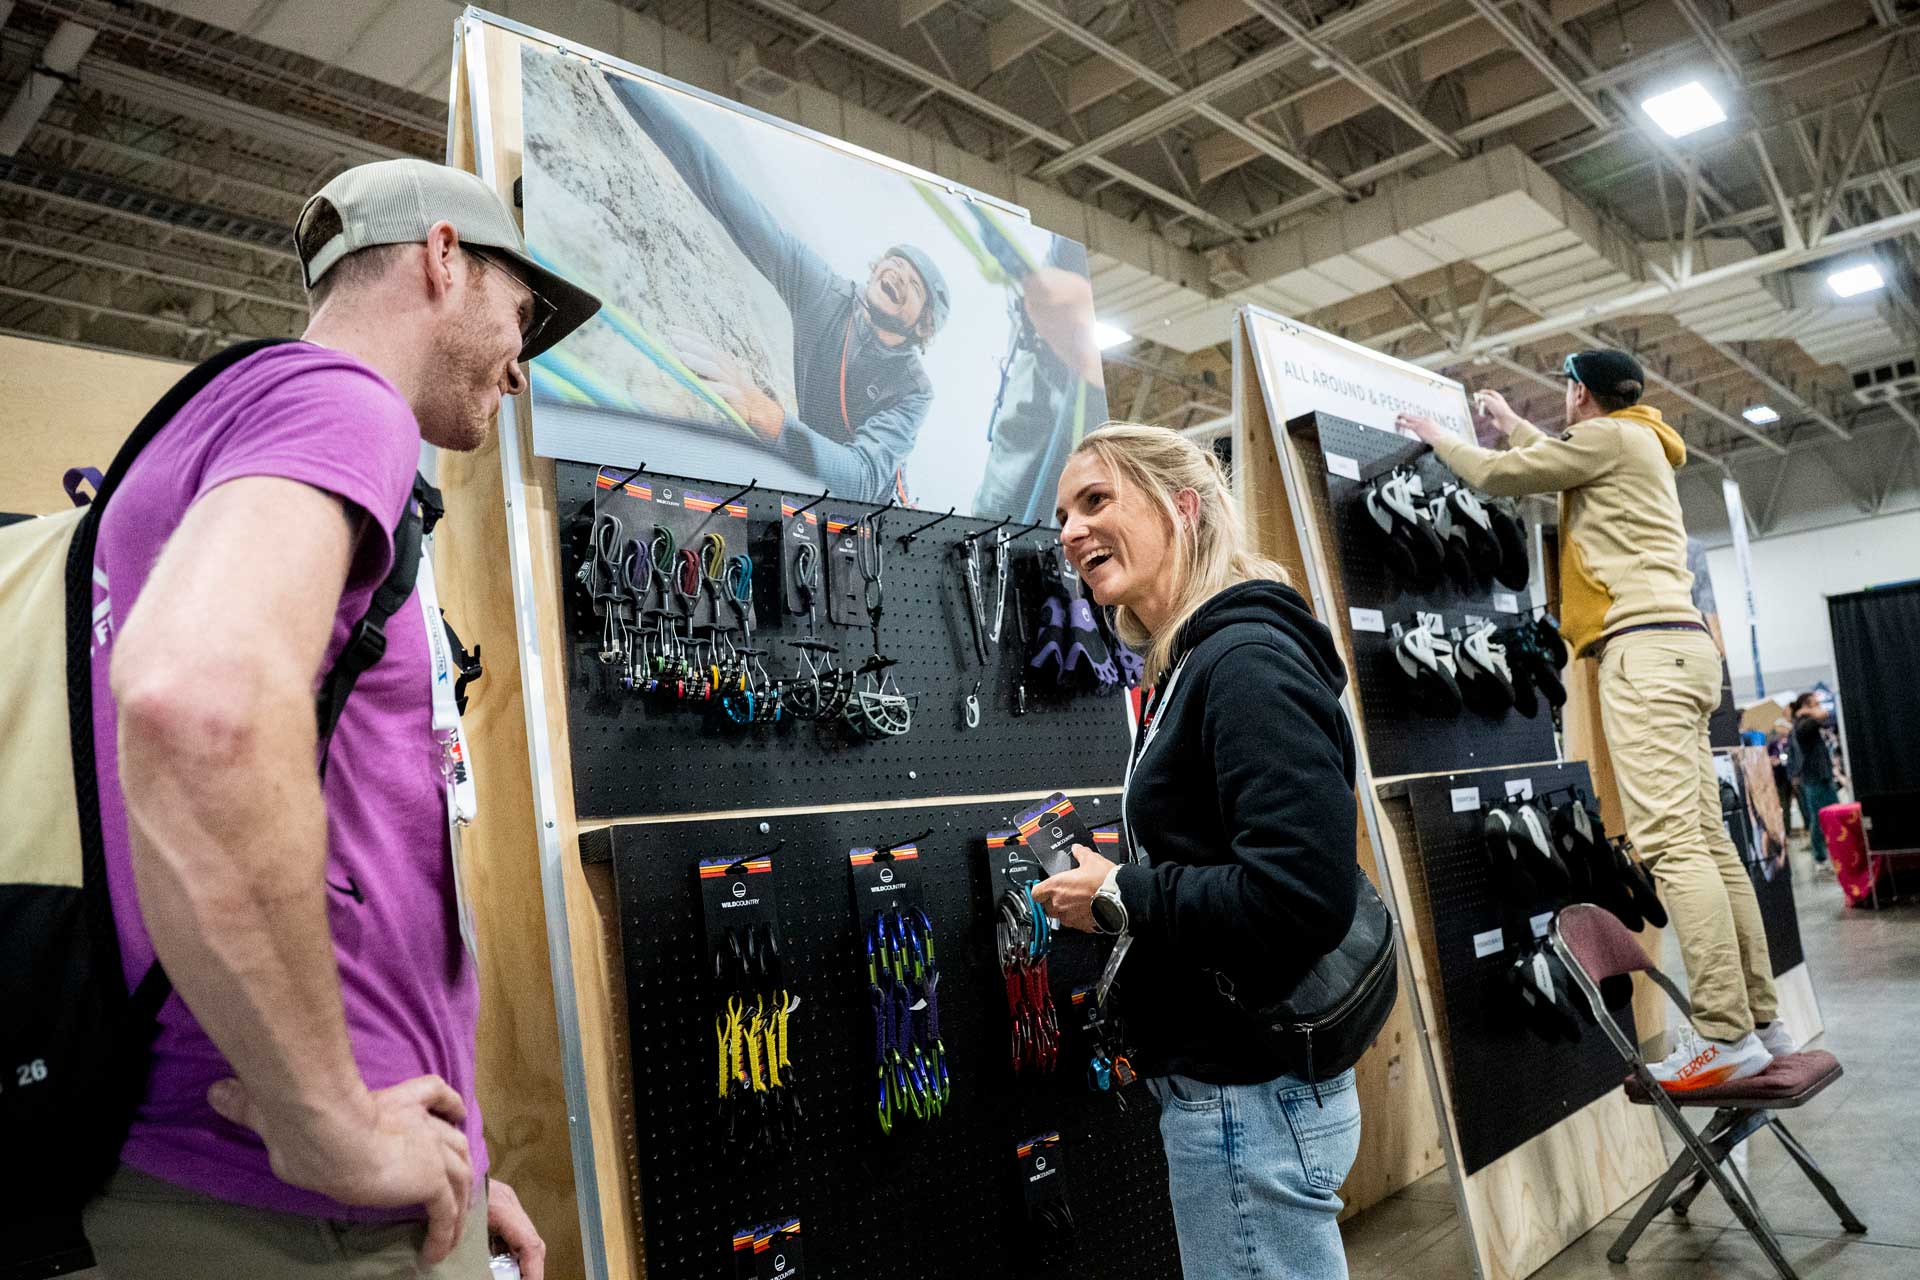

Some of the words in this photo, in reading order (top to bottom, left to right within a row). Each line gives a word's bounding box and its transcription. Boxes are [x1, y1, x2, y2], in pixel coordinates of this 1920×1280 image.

[1284, 360, 1311, 384] ALL
[1313, 369, 1366, 402] AROUND
[1367, 388, 1379, 406] &
[870, 883, 907, 893] WILDCOUNTRY
[721, 898, 760, 909] WILDCOUNTRY
[16, 1059, 48, 1087] 26
[1674, 1042, 1720, 1080] TERREX
